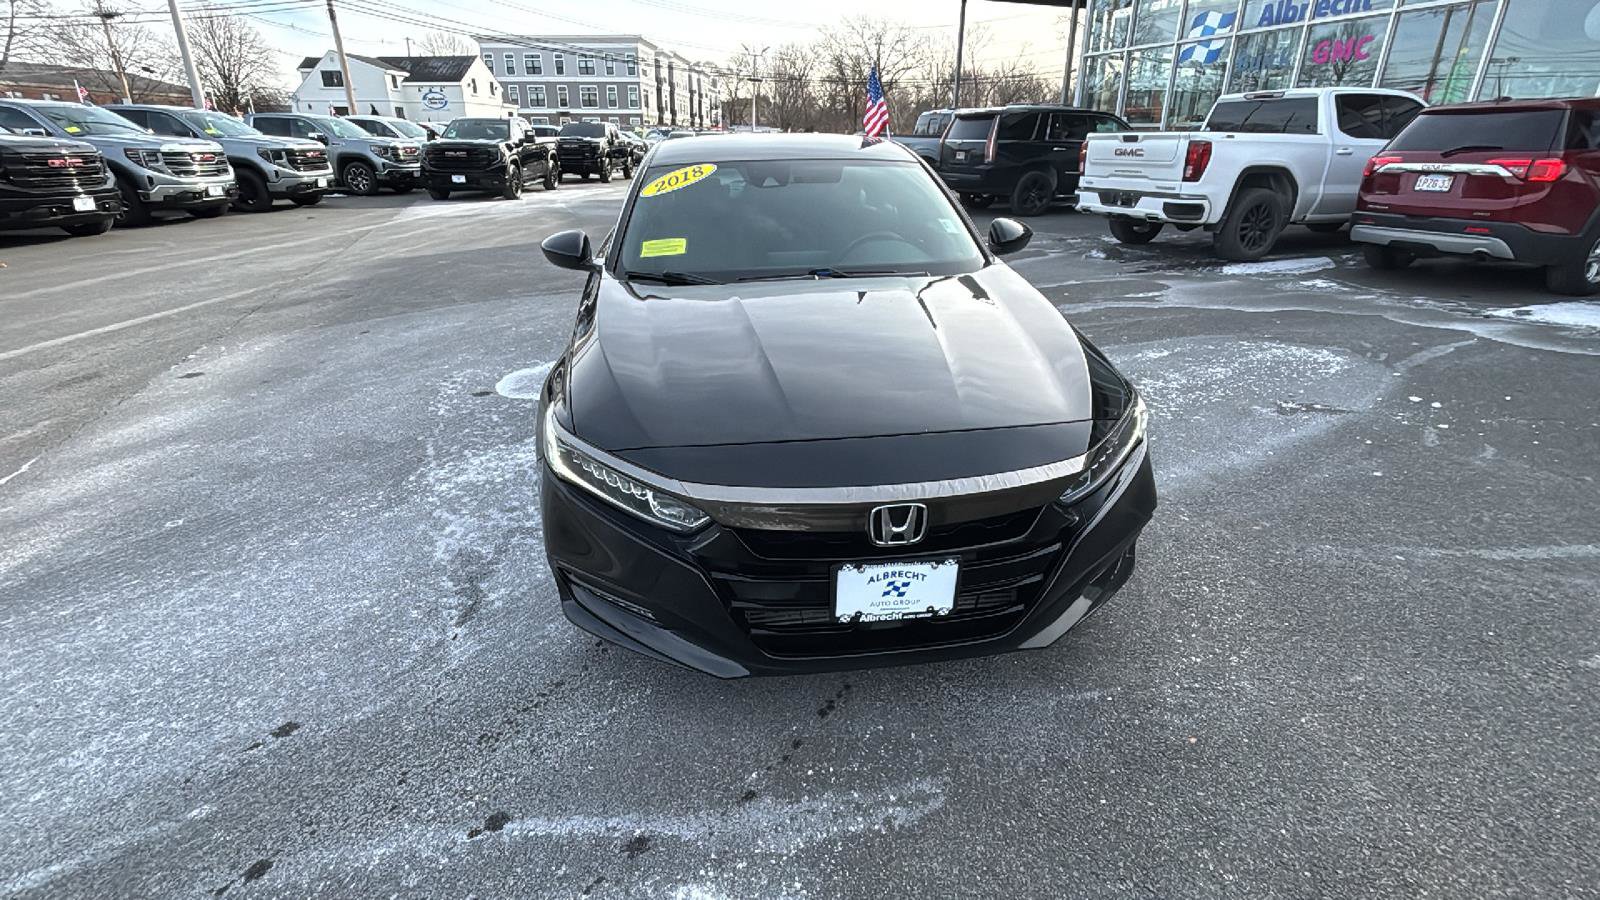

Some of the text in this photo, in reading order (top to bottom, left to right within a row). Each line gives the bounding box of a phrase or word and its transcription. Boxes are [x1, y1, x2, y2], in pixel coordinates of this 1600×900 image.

[1312, 34, 1375, 65] GMC
[1114, 148, 1145, 157] GMC
[654, 166, 704, 192] 2018
[867, 571, 927, 585] ALBRECHT
[859, 613, 903, 623] Albrecht
